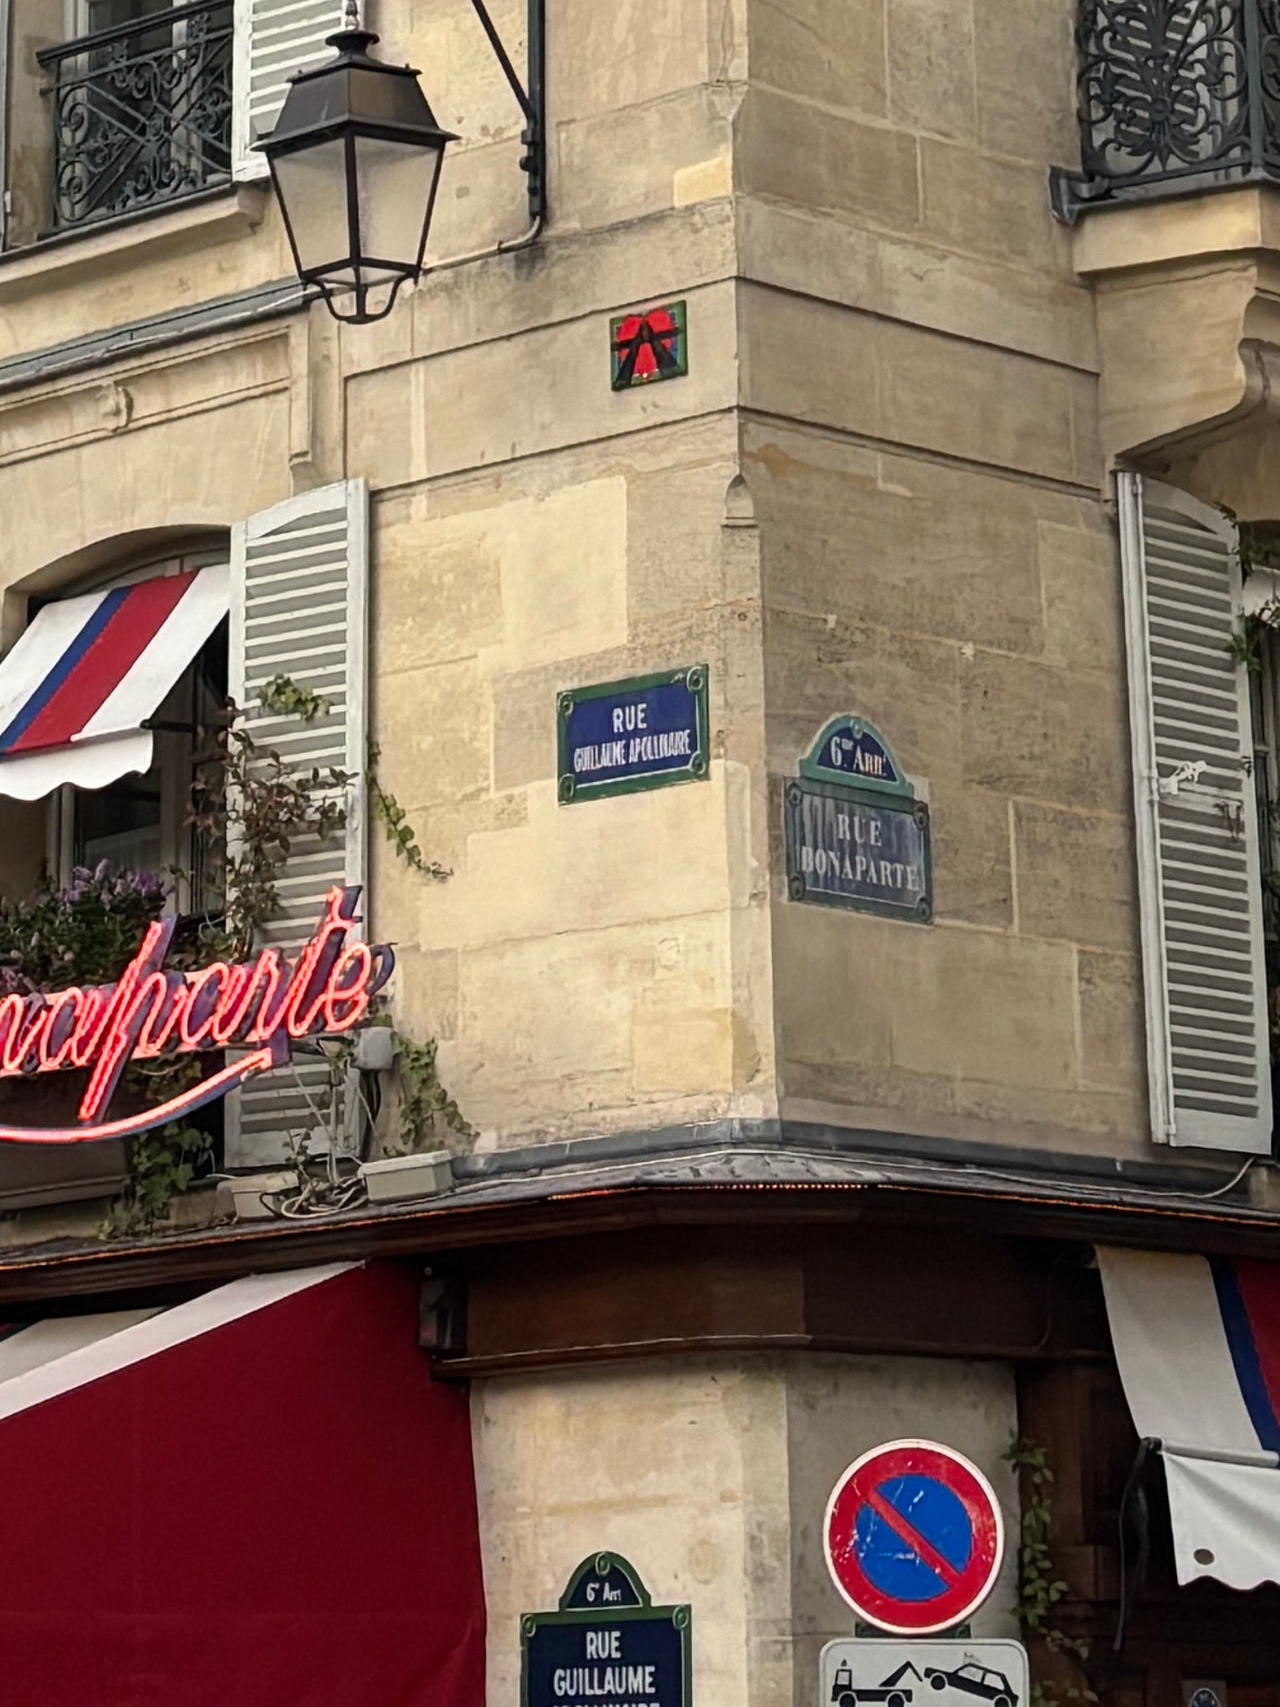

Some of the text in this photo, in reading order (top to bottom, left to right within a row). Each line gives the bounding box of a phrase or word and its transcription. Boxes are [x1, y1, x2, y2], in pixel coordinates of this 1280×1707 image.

[612, 703, 647, 733] RUE
[574, 740, 626, 772] GUILLAUME
[837, 813, 882, 847] RUE
[801, 845, 920, 891] BONAPARTE
[586, 1631, 621, 1660] RUE
[553, 1666, 656, 1696] GUILLAUME
